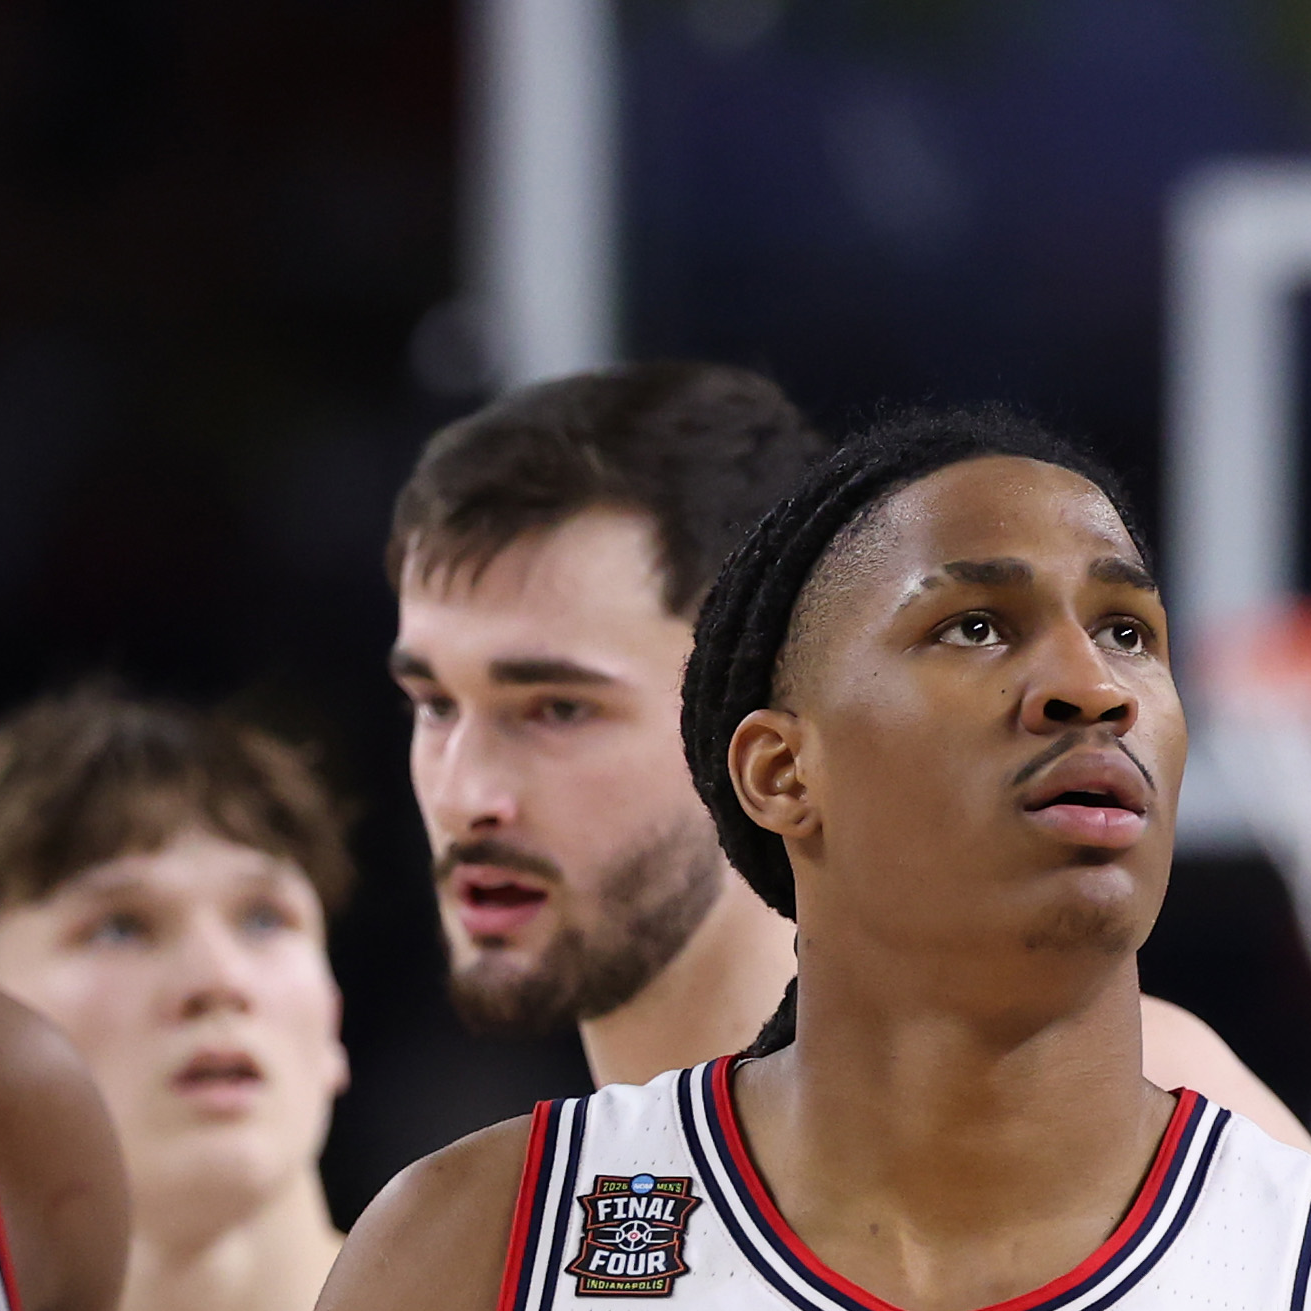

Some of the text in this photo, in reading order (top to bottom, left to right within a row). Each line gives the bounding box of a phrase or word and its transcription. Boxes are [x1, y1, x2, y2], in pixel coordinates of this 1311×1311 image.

[597, 1197, 675, 1221] FINAL
[589, 1249, 667, 1276] FOUR
[586, 1279, 664, 1290] INDIANAPOLIS
